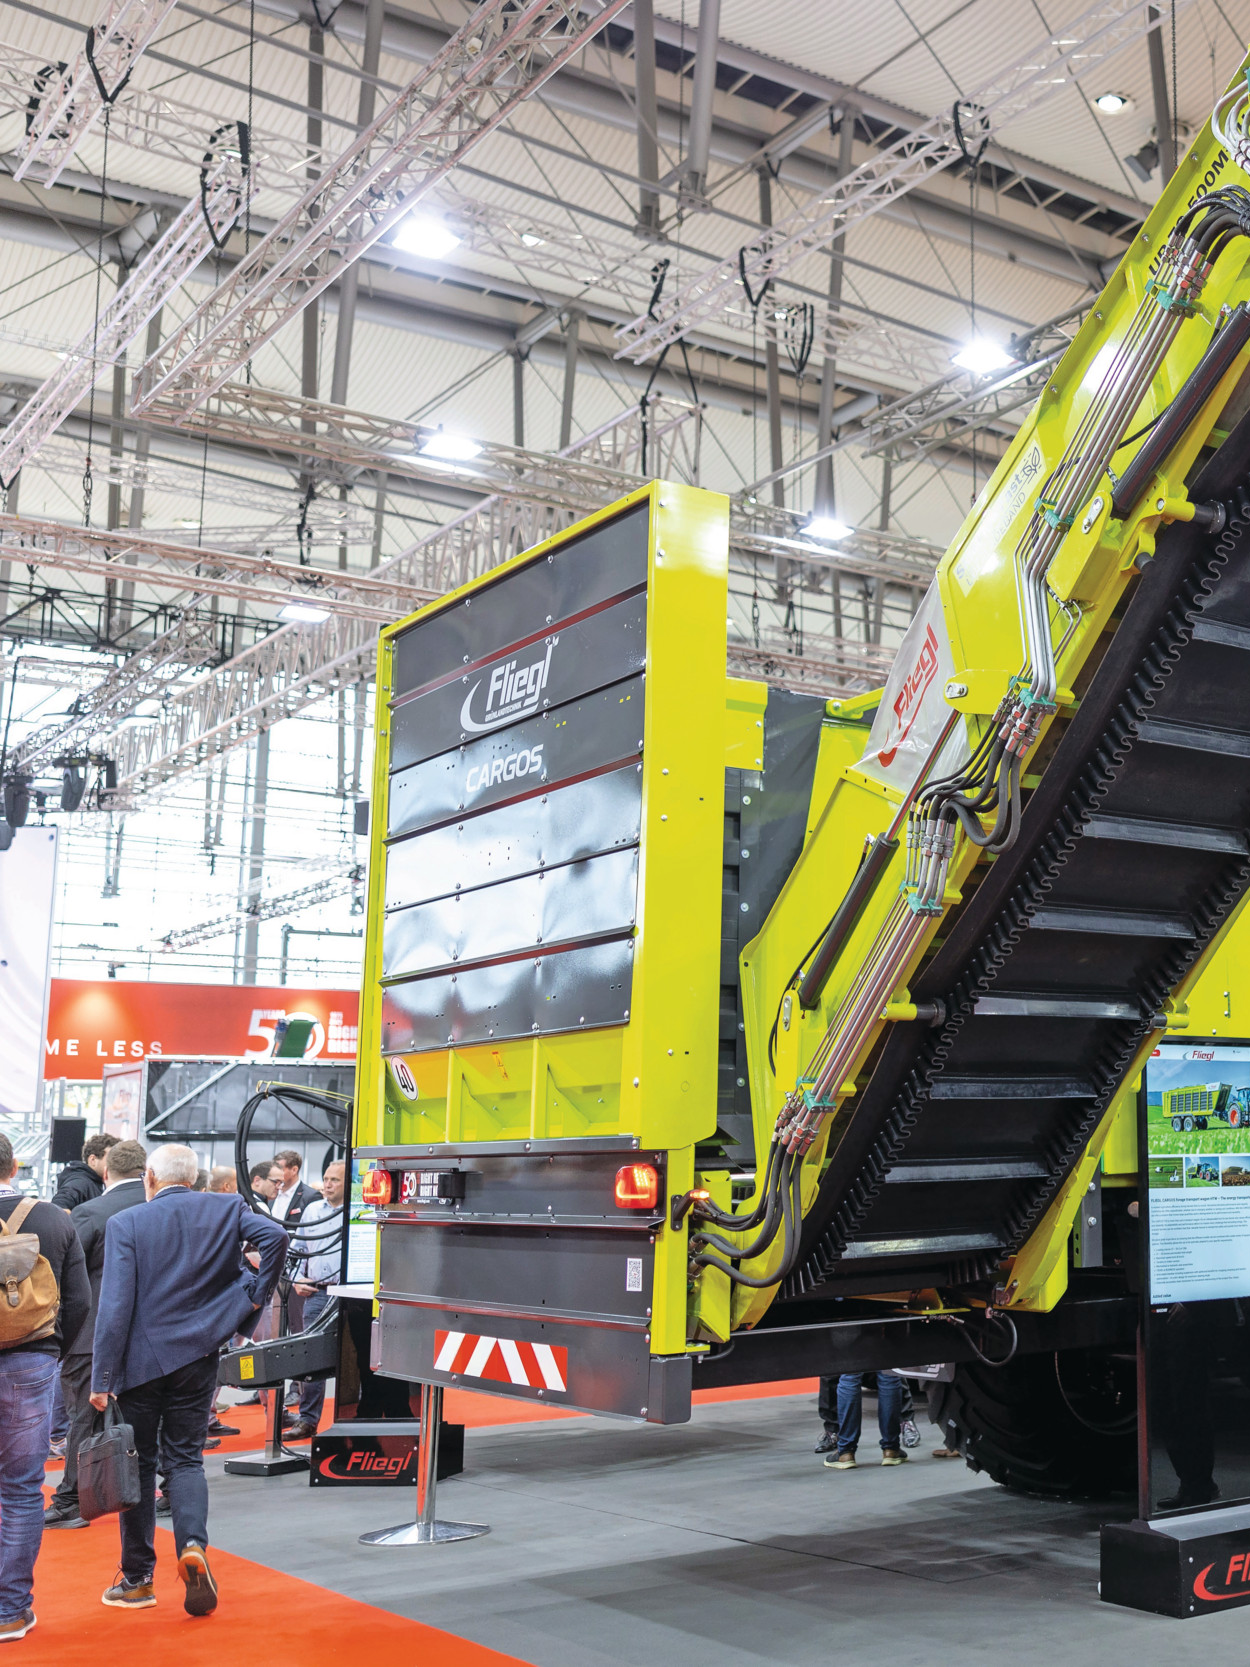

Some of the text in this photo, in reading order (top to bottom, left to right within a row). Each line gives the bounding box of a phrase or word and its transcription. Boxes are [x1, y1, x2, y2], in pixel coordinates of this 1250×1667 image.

[485, 643, 554, 712] Fliegl
[893, 621, 939, 731] Fliegl
[466, 743, 544, 793] CARGOS
[96, 1040, 163, 1056] LESS
[1191, 1050, 1215, 1062] Fliegl
[395, 1063, 414, 1093] 40
[402, 1172, 417, 1197] 50
[346, 1451, 413, 1475] Fliegl
